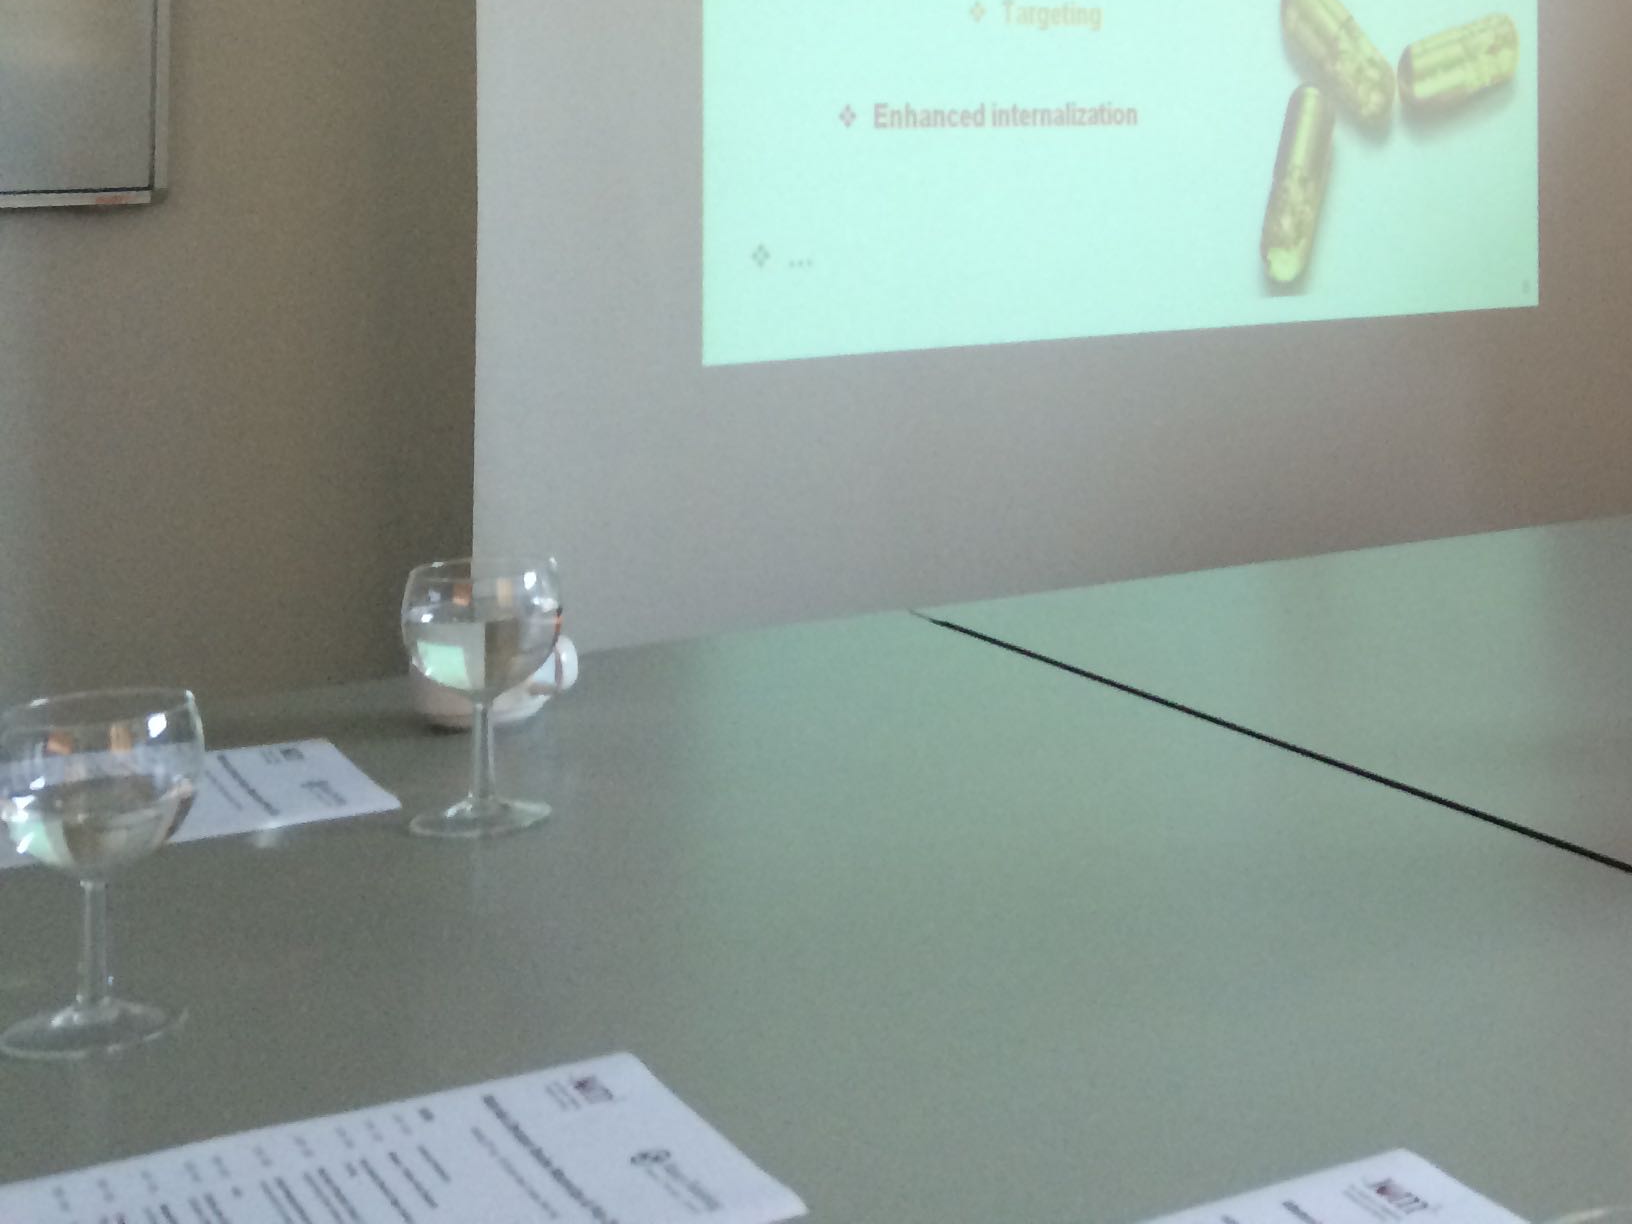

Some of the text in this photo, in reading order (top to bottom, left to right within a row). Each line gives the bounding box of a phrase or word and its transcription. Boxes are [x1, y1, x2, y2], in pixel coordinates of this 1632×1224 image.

[1002, 0, 1103, 31] Targeting
[872, 102, 1139, 131] Enhanced internalization
